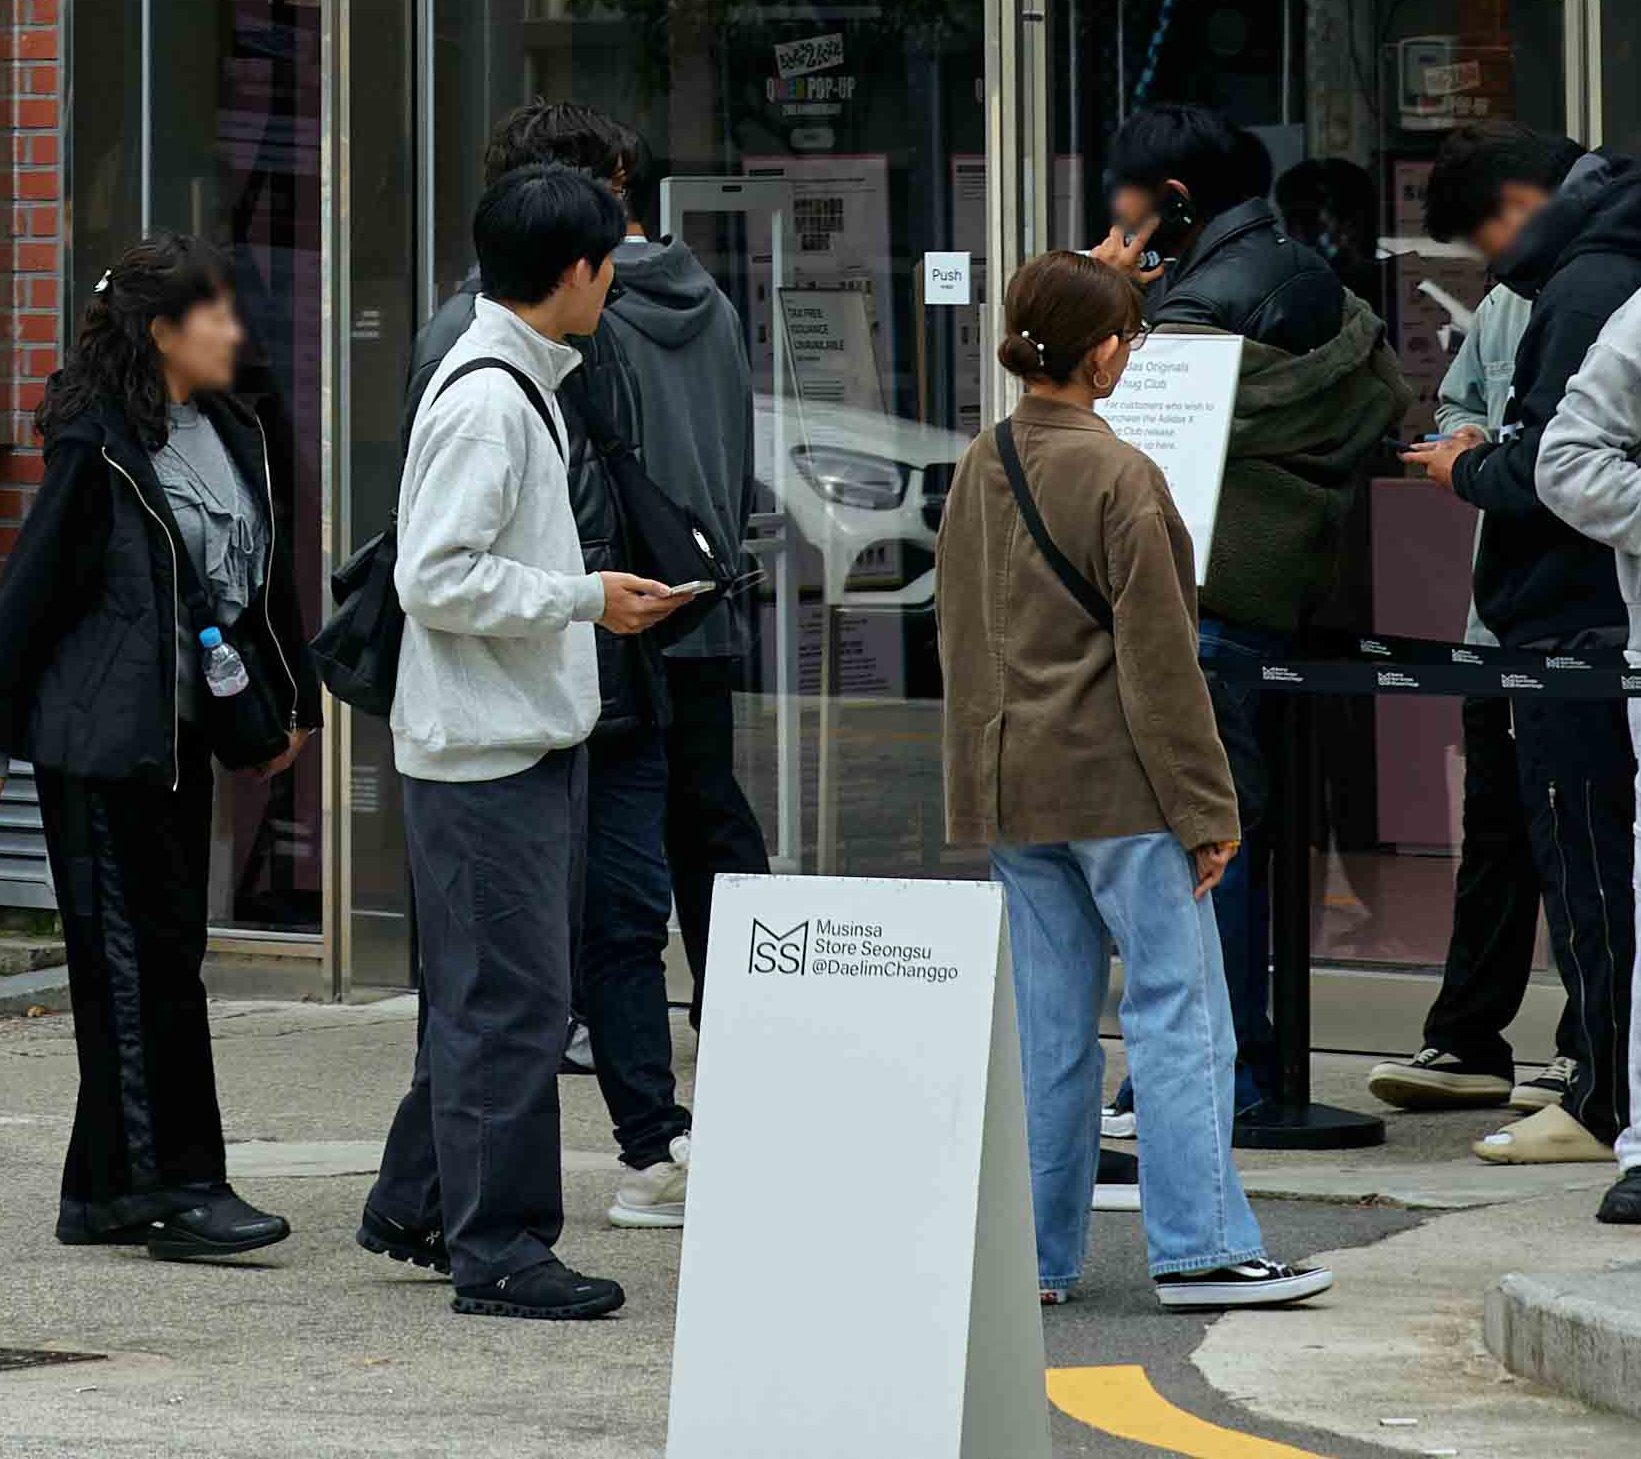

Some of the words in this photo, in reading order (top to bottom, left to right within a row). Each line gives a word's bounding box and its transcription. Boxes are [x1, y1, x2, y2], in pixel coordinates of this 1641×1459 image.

[807, 76, 856, 101] POP-UP
[931, 269, 963, 282] Push
[1145, 360, 1189, 375] Originals
[1119, 378, 1143, 390] hug
[1144, 378, 1167, 389] Club
[816, 918, 883, 938] Musinsa
[815, 938, 857, 956] Store
[860, 940, 932, 962] Seongsu
[812, 959, 959, 983] @DaelimChanggo
